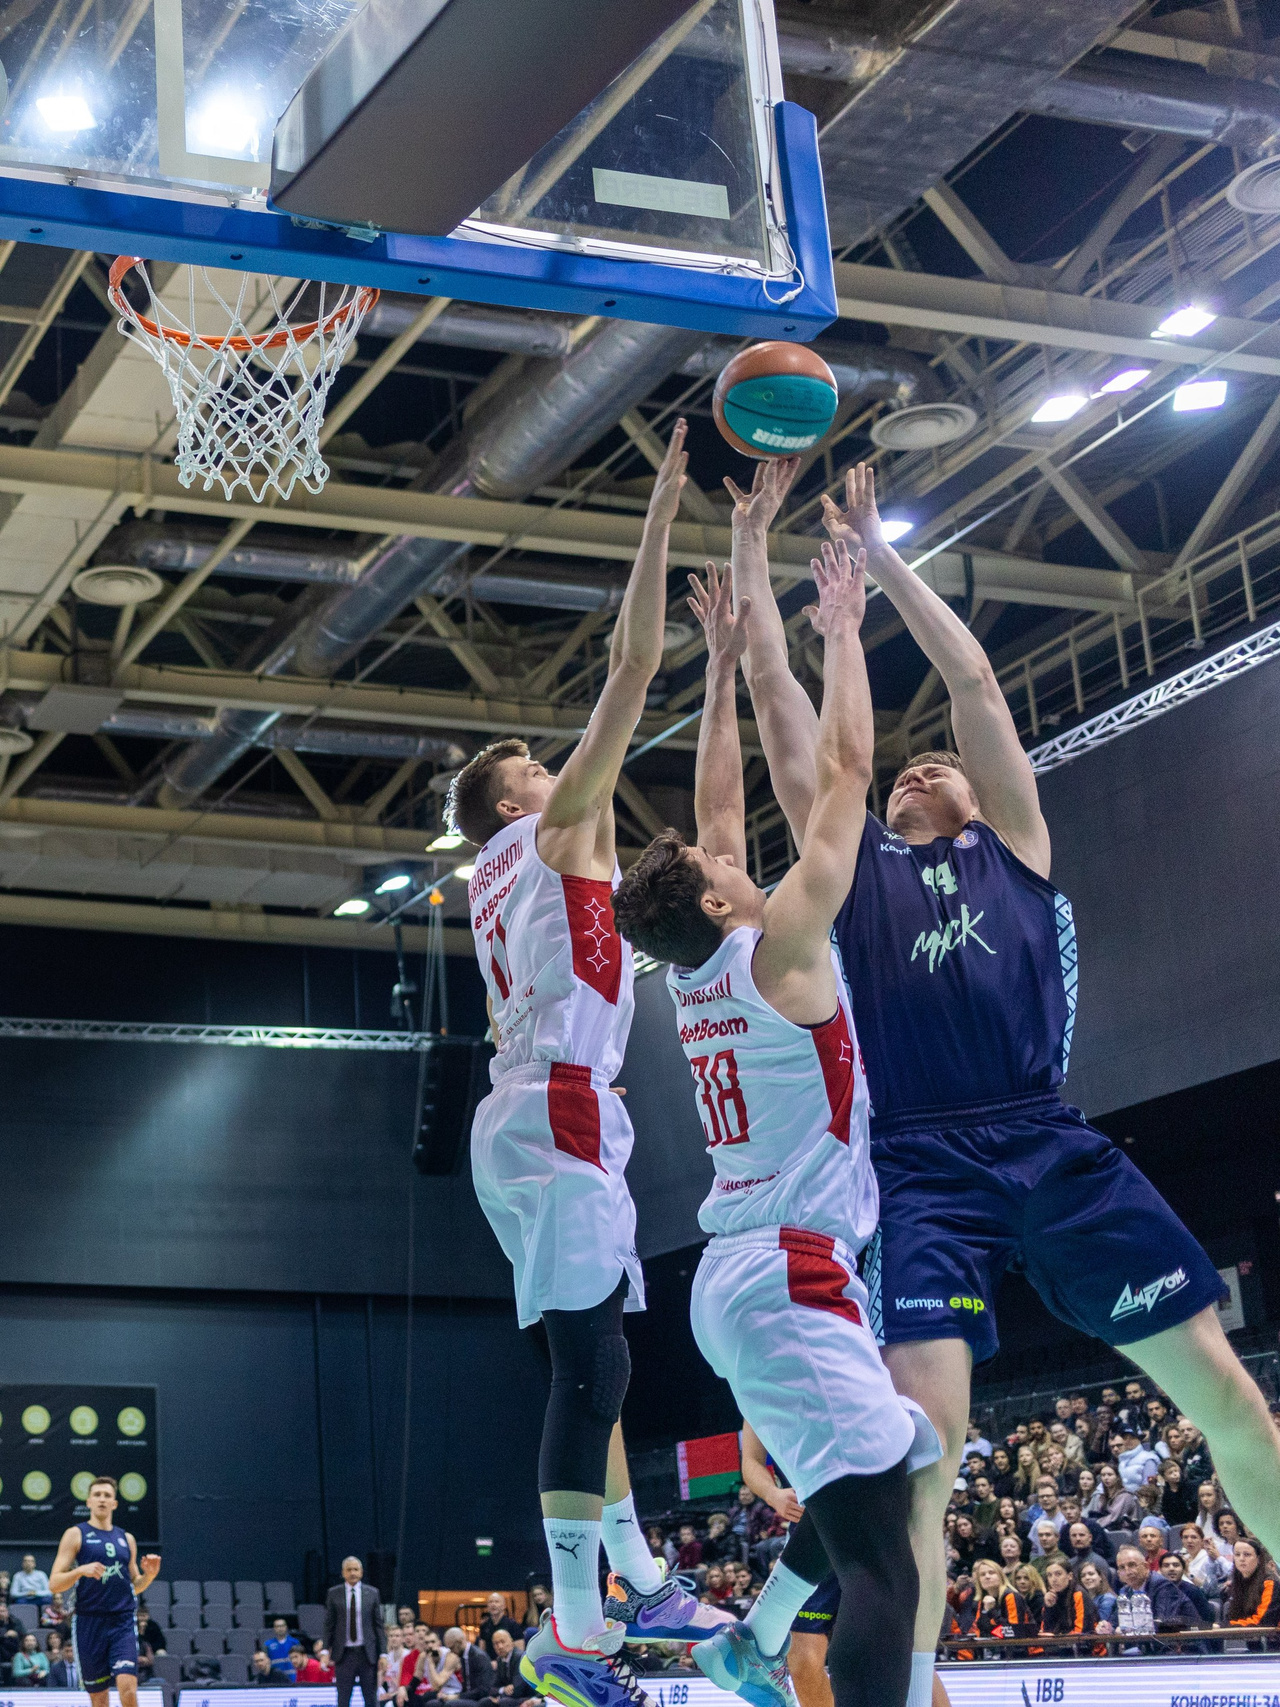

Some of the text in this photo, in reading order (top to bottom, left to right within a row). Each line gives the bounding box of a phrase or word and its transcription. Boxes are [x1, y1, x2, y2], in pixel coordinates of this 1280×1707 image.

[474, 874, 518, 930] etBoom
[895, 1297, 944, 1311] Kempa
[104, 1542, 116, 1558] 9
[669, 1684, 689, 1705] IBB
[1036, 1678, 1065, 1703] IBB
